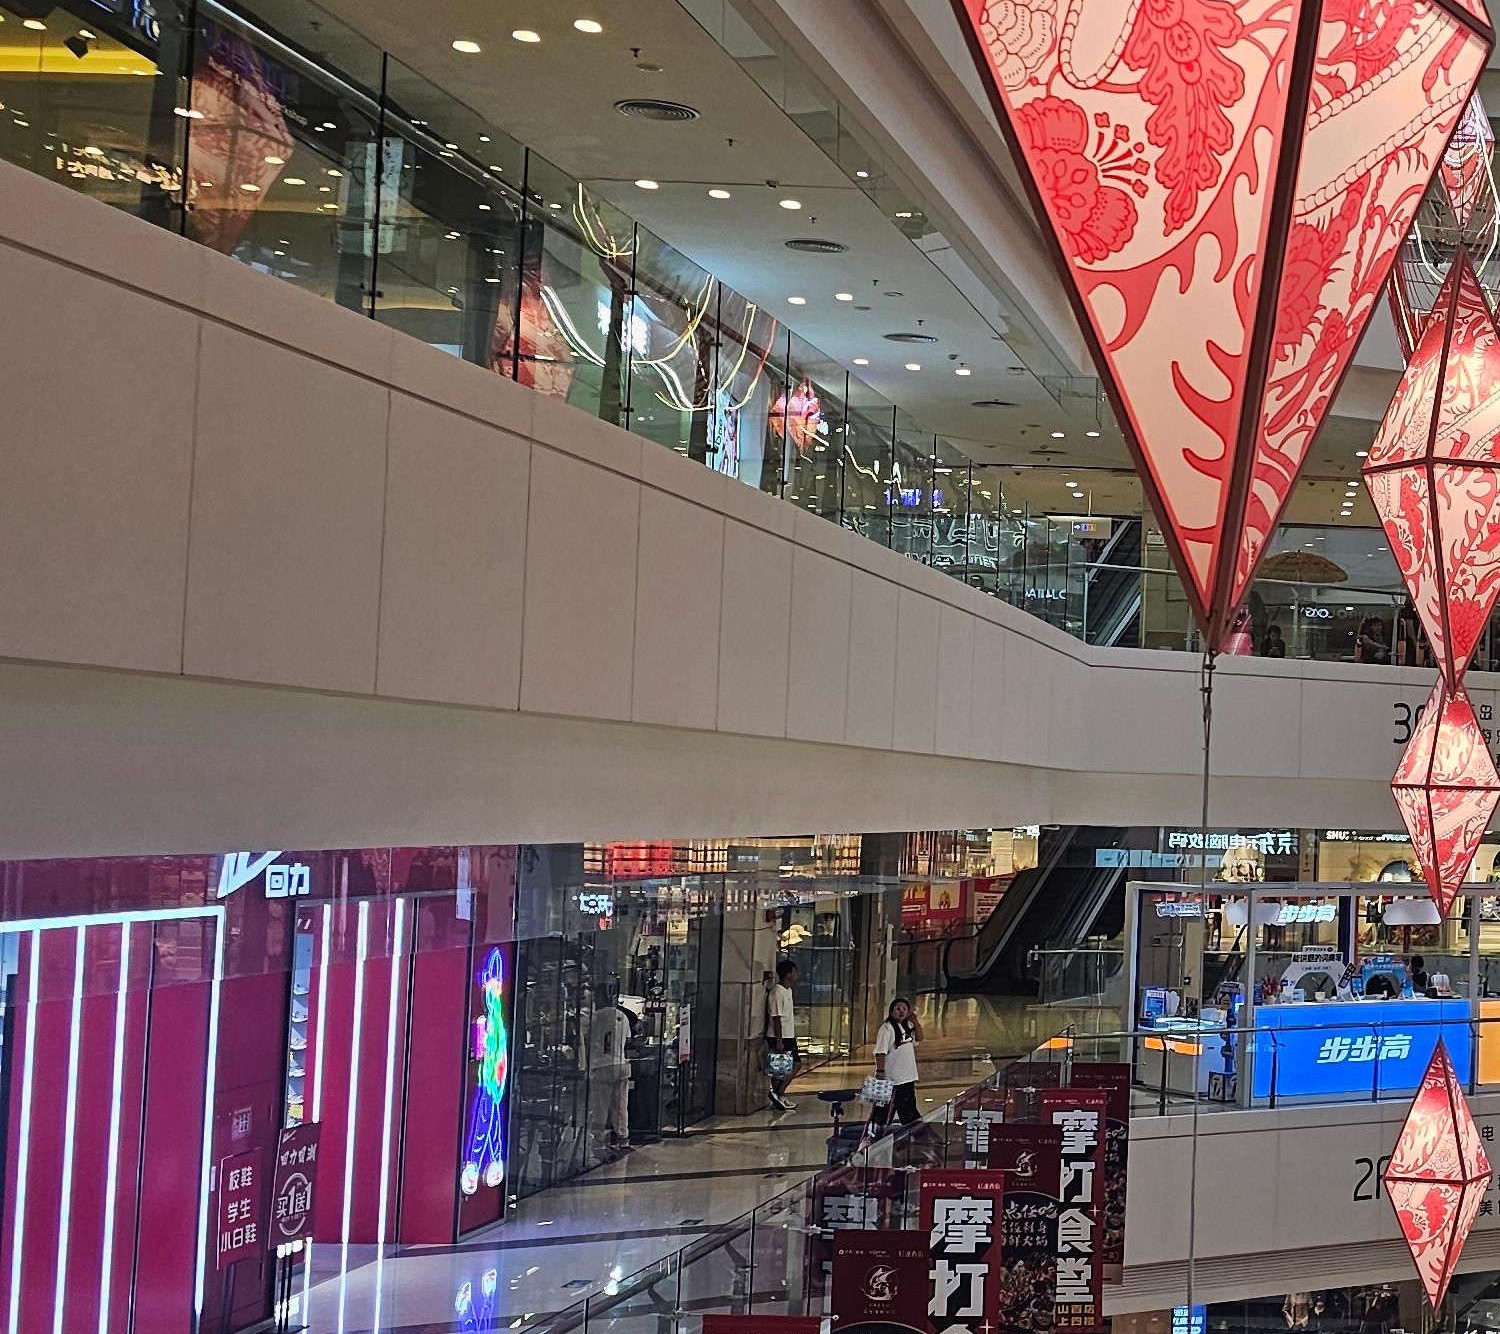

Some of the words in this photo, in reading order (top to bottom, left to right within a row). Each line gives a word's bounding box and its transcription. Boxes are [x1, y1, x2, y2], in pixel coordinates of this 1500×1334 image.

[265, 863, 310, 898] 回力
[1277, 904, 1337, 924] 步步高
[1317, 1033, 1413, 1065] 步步高
[228, 1166, 253, 1192] 校鞋
[227, 1197, 252, 1224] 学生
[220, 1223, 257, 1253] 小白鞋
